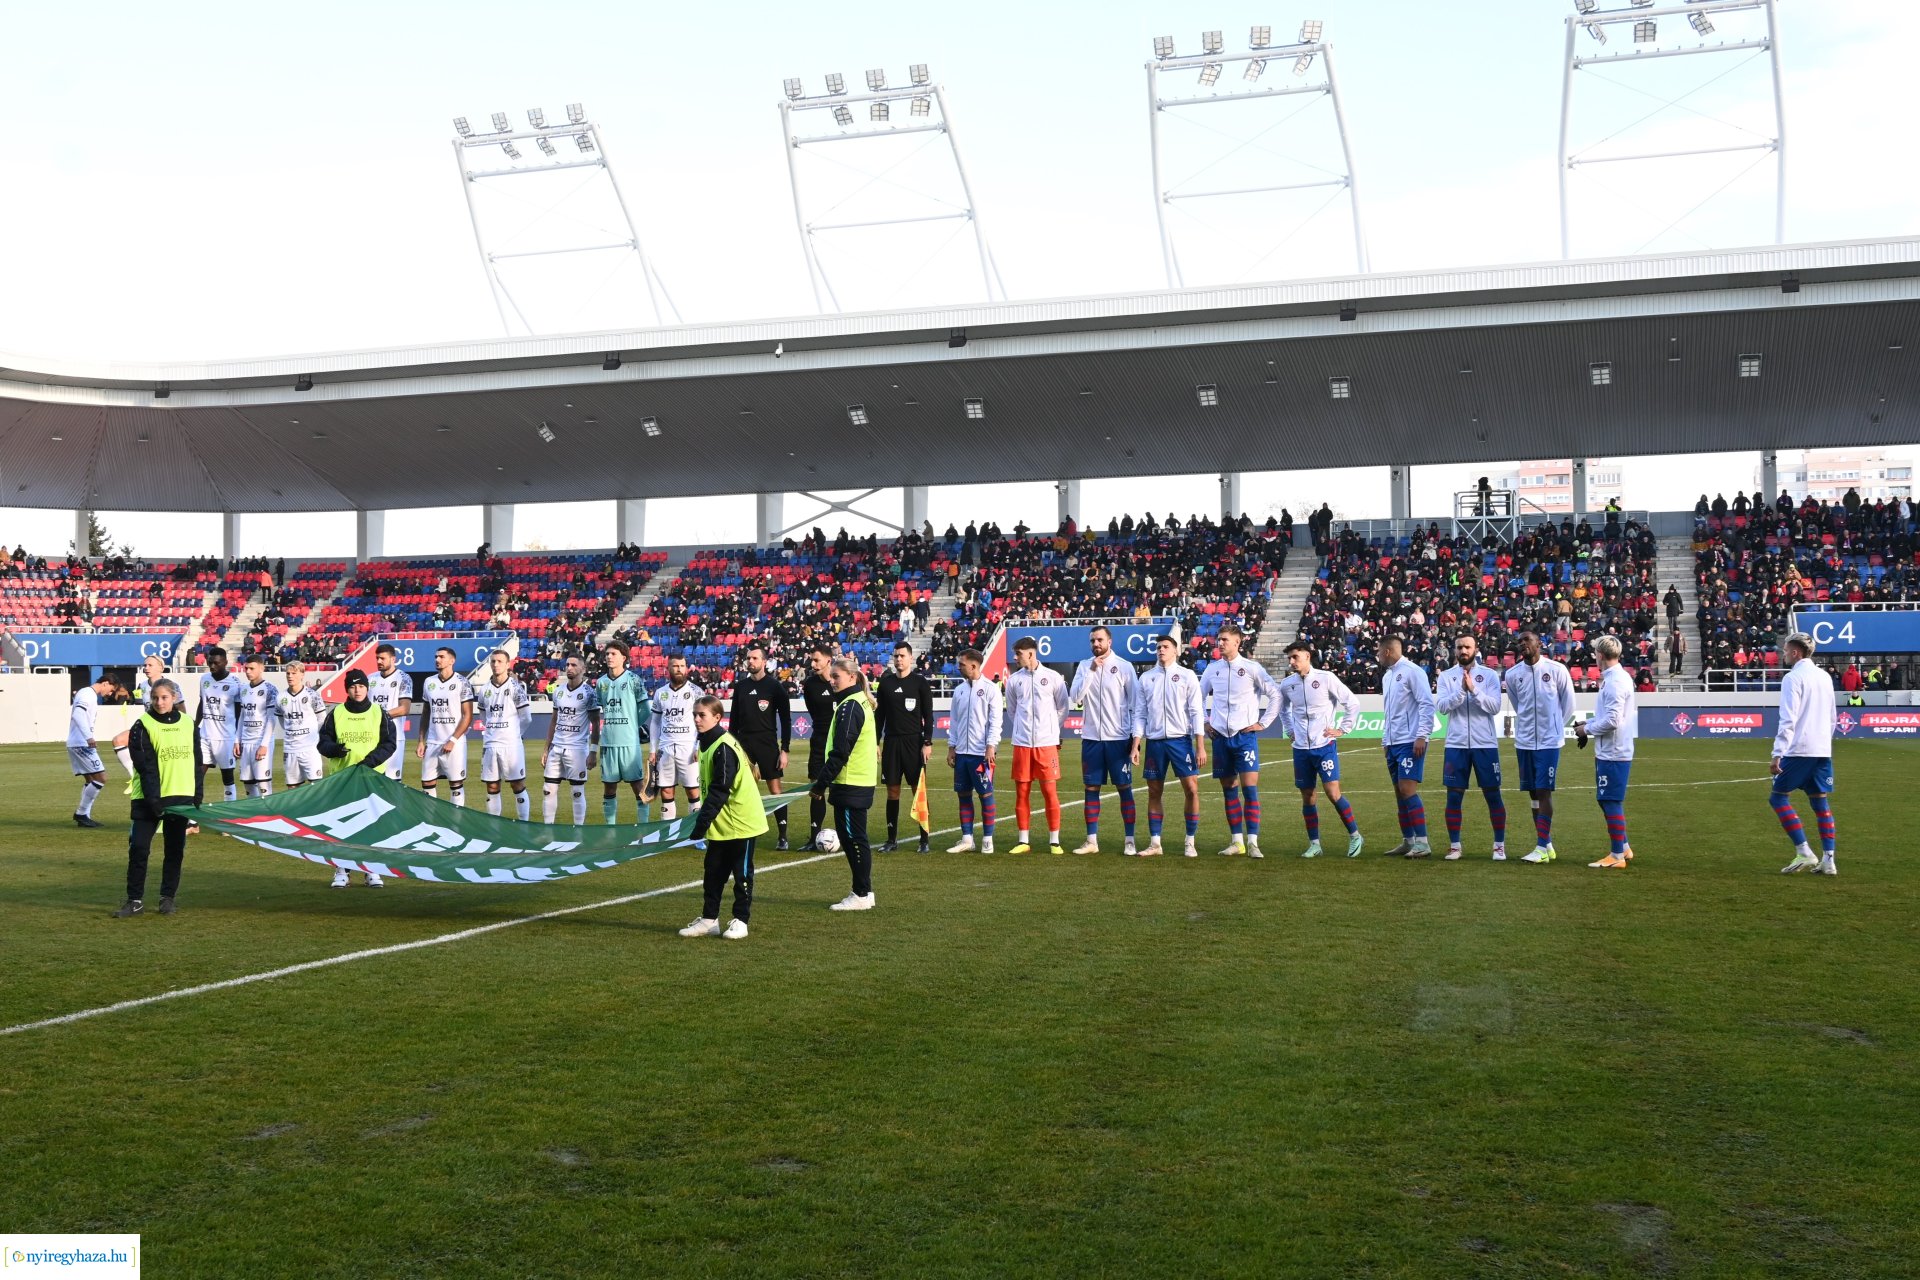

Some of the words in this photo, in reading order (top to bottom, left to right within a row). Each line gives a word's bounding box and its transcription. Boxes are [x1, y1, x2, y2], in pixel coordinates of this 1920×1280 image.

[1812, 620, 1856, 645] C4
[22, 640, 51, 659] D1
[140, 640, 172, 659] C8
[1126, 633, 1159, 655] C5
[1705, 715, 1754, 725] HAJRÁ
[1869, 714, 1920, 725] HAJRÁ
[1185, 753, 1192, 764] 4
[1243, 750, 1256, 761] 24
[1321, 759, 1335, 771] 88
[1401, 758, 1413, 768] 45
[1548, 766, 1555, 778] 8
